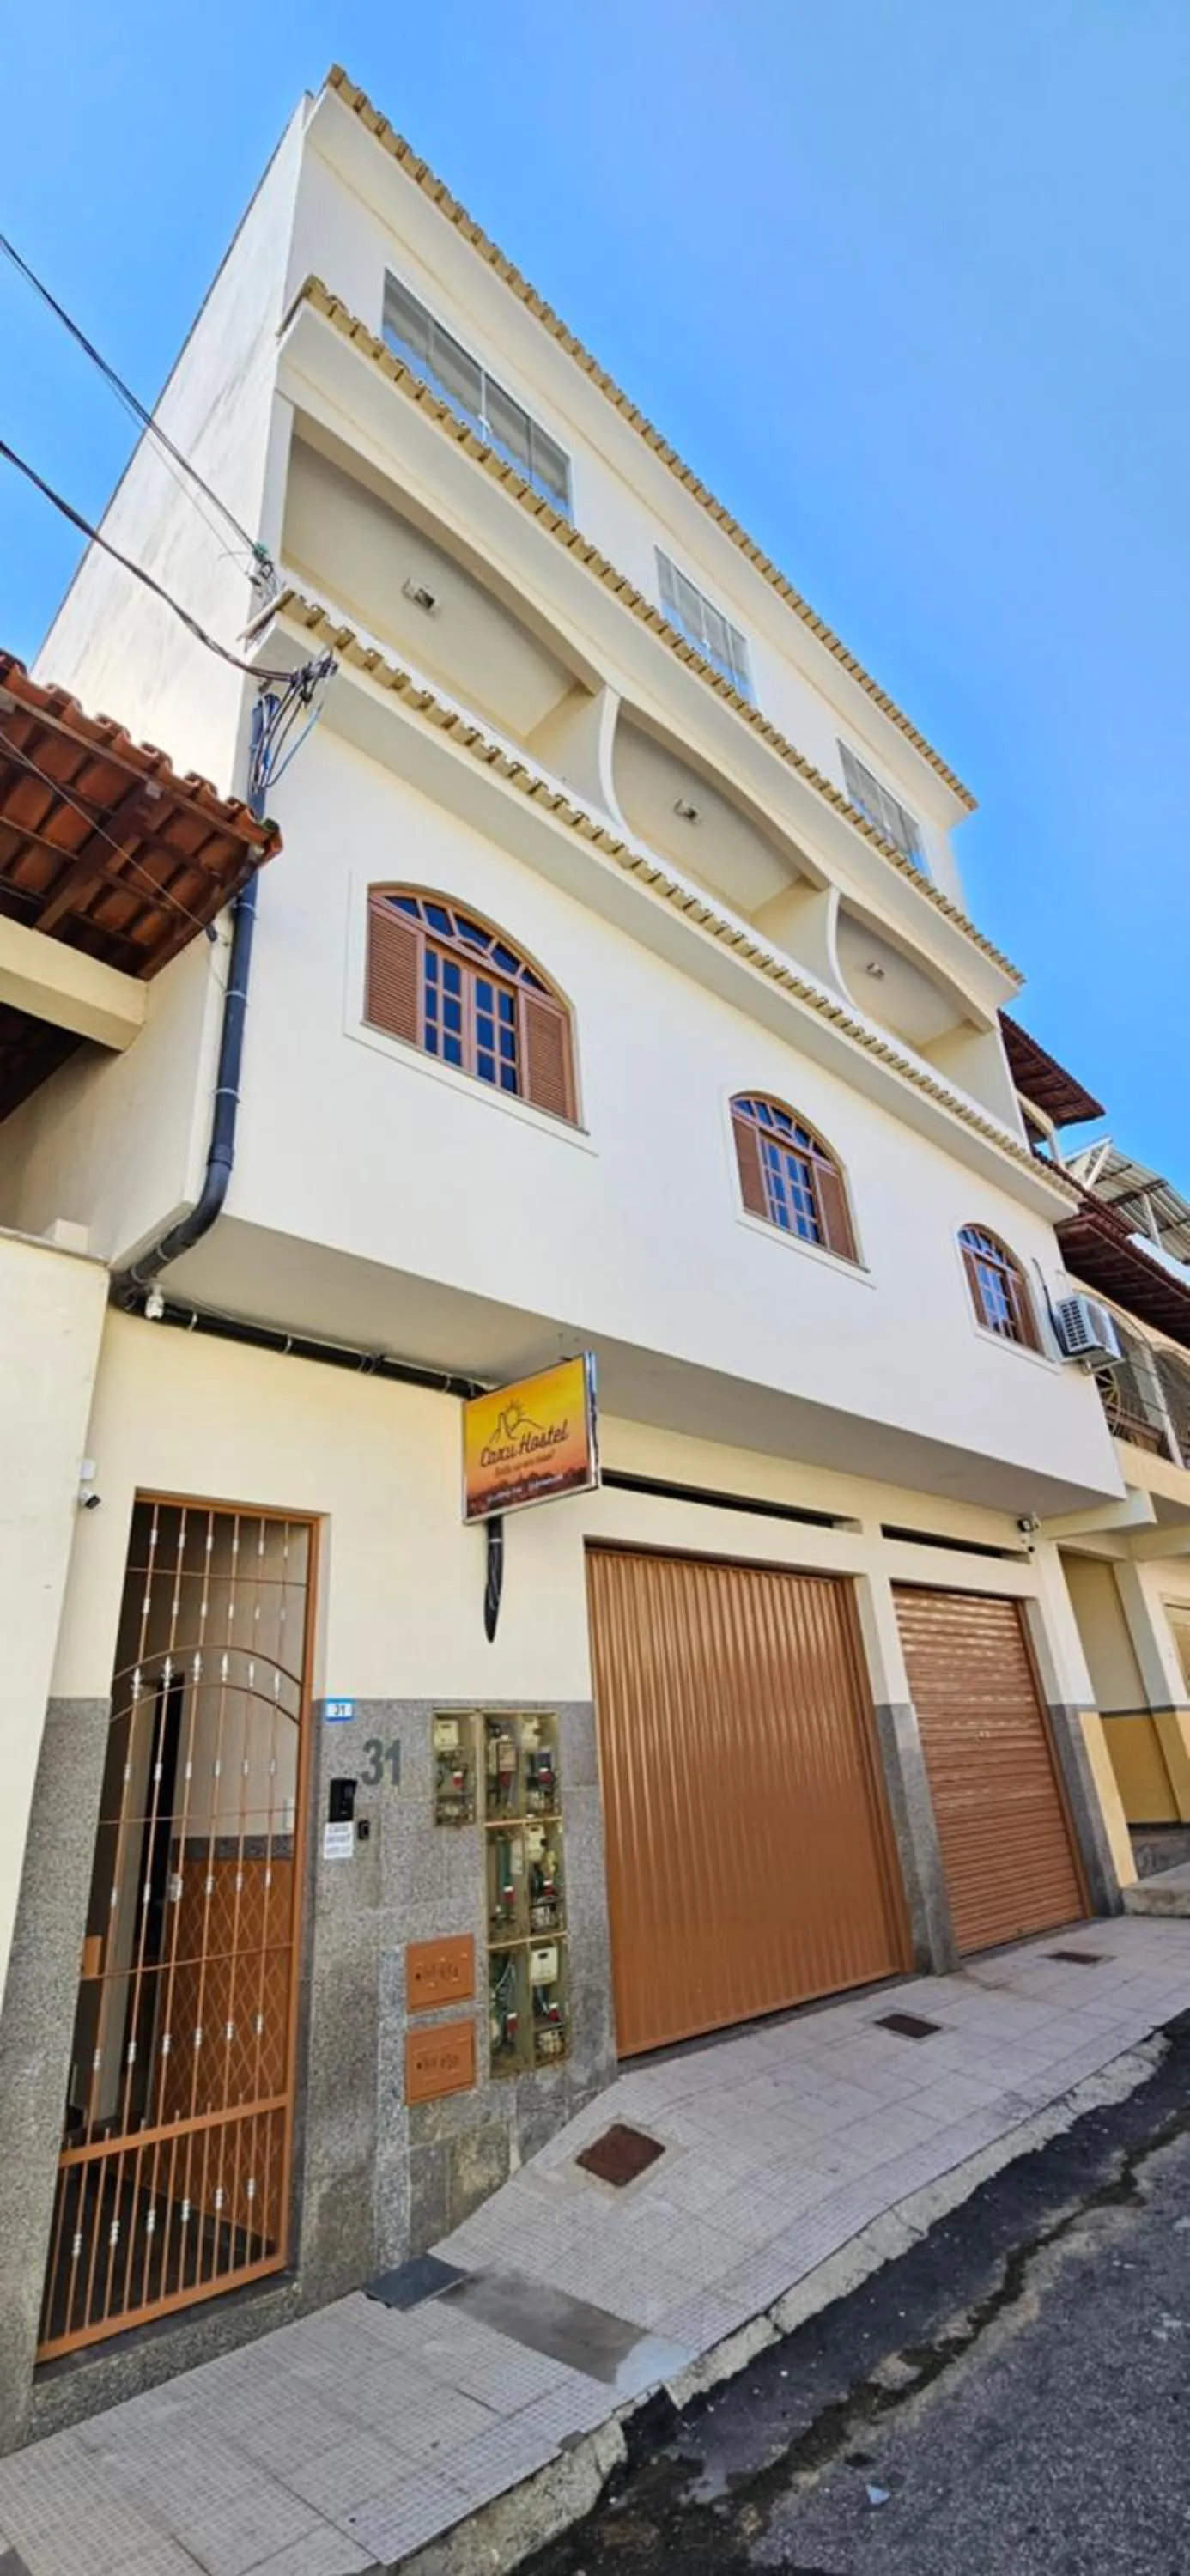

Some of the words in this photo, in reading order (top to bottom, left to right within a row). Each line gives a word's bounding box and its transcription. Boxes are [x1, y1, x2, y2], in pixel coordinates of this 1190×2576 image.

[517, 1418, 569, 1455] Hostel
[334, 1704, 346, 1716] 31
[361, 1738, 402, 1786] 31
